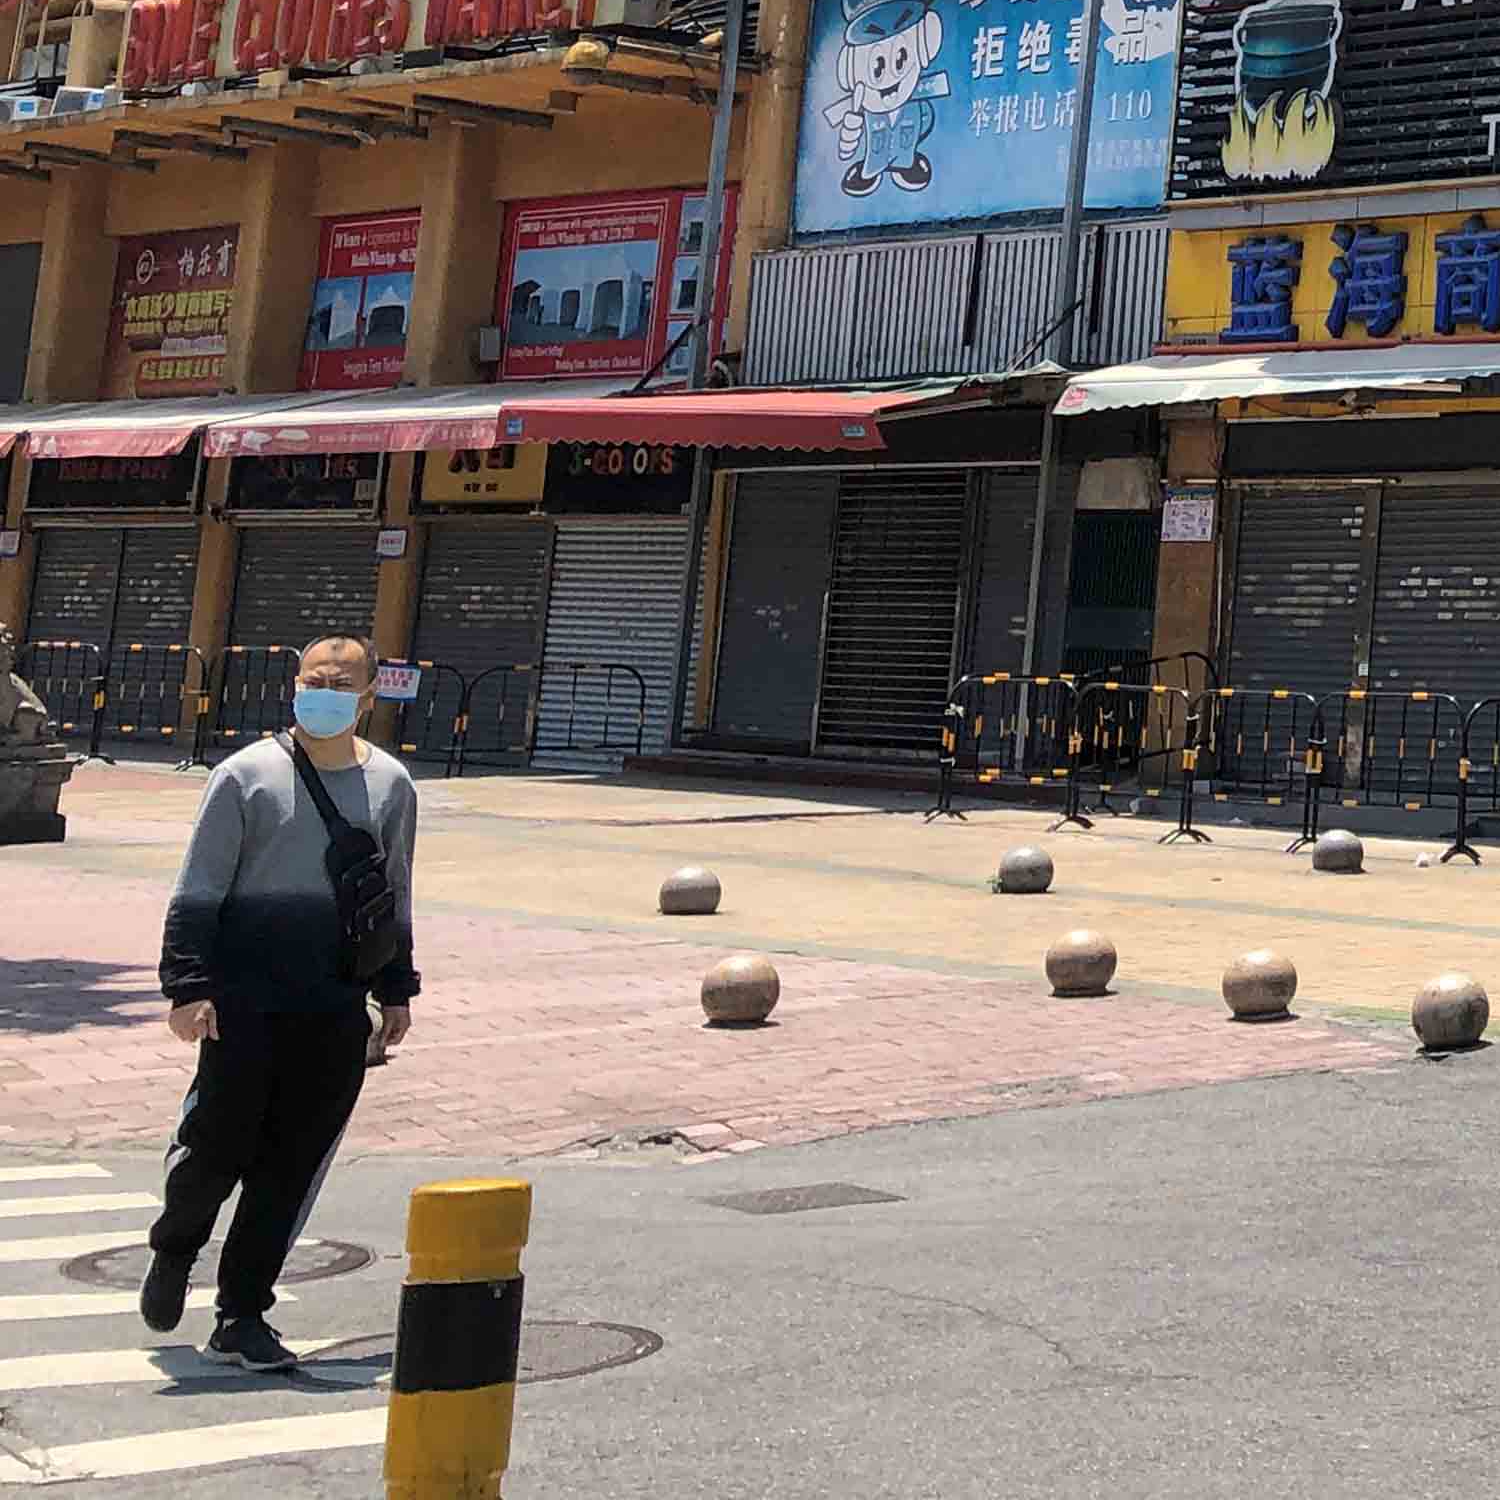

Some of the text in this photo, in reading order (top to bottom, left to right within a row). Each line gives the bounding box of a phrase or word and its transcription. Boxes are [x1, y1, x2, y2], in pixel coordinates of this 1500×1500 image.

[972, 11, 1149, 80] 拒绝毒品
[967, 88, 1078, 138] 举报电话
[1104, 88, 1152, 123] 110
